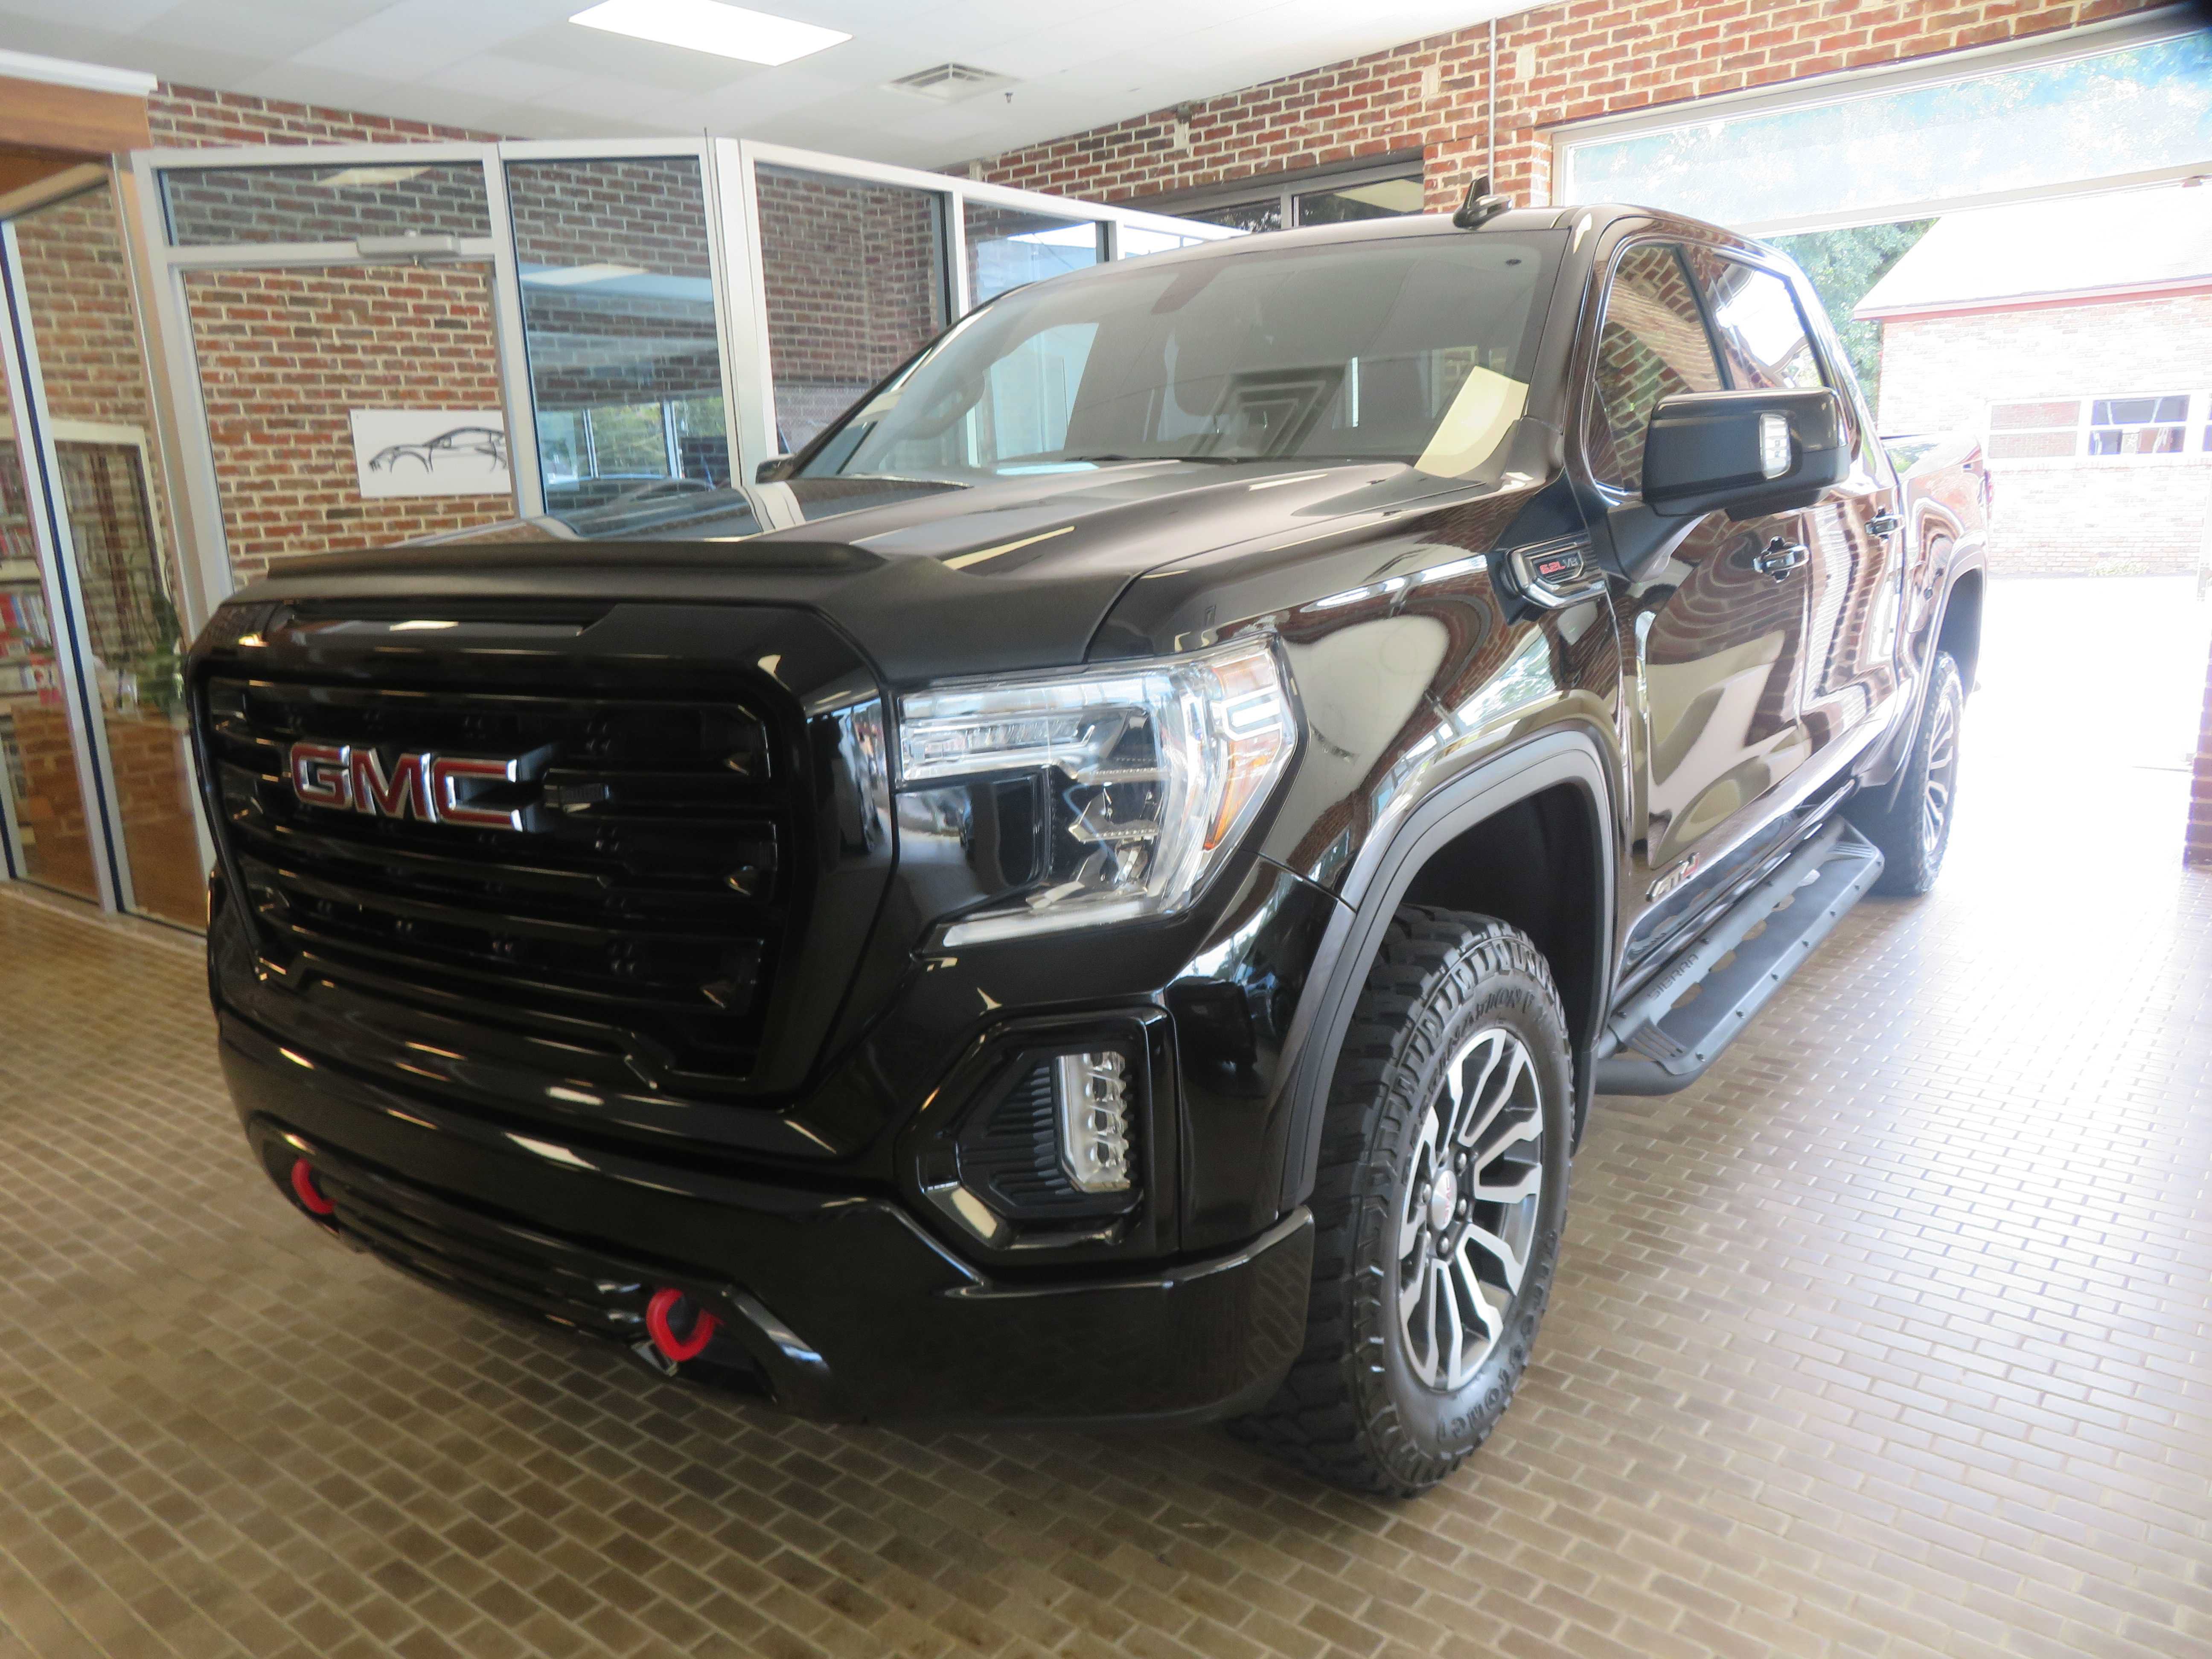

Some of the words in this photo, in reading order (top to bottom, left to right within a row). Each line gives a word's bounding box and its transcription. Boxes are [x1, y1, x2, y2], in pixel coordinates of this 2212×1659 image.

[1562, 557, 1578, 568] V8
[291, 741, 523, 833] GMC
[1645, 852, 1700, 902] AT4
[1647, 954, 1699, 999] SIERRA
